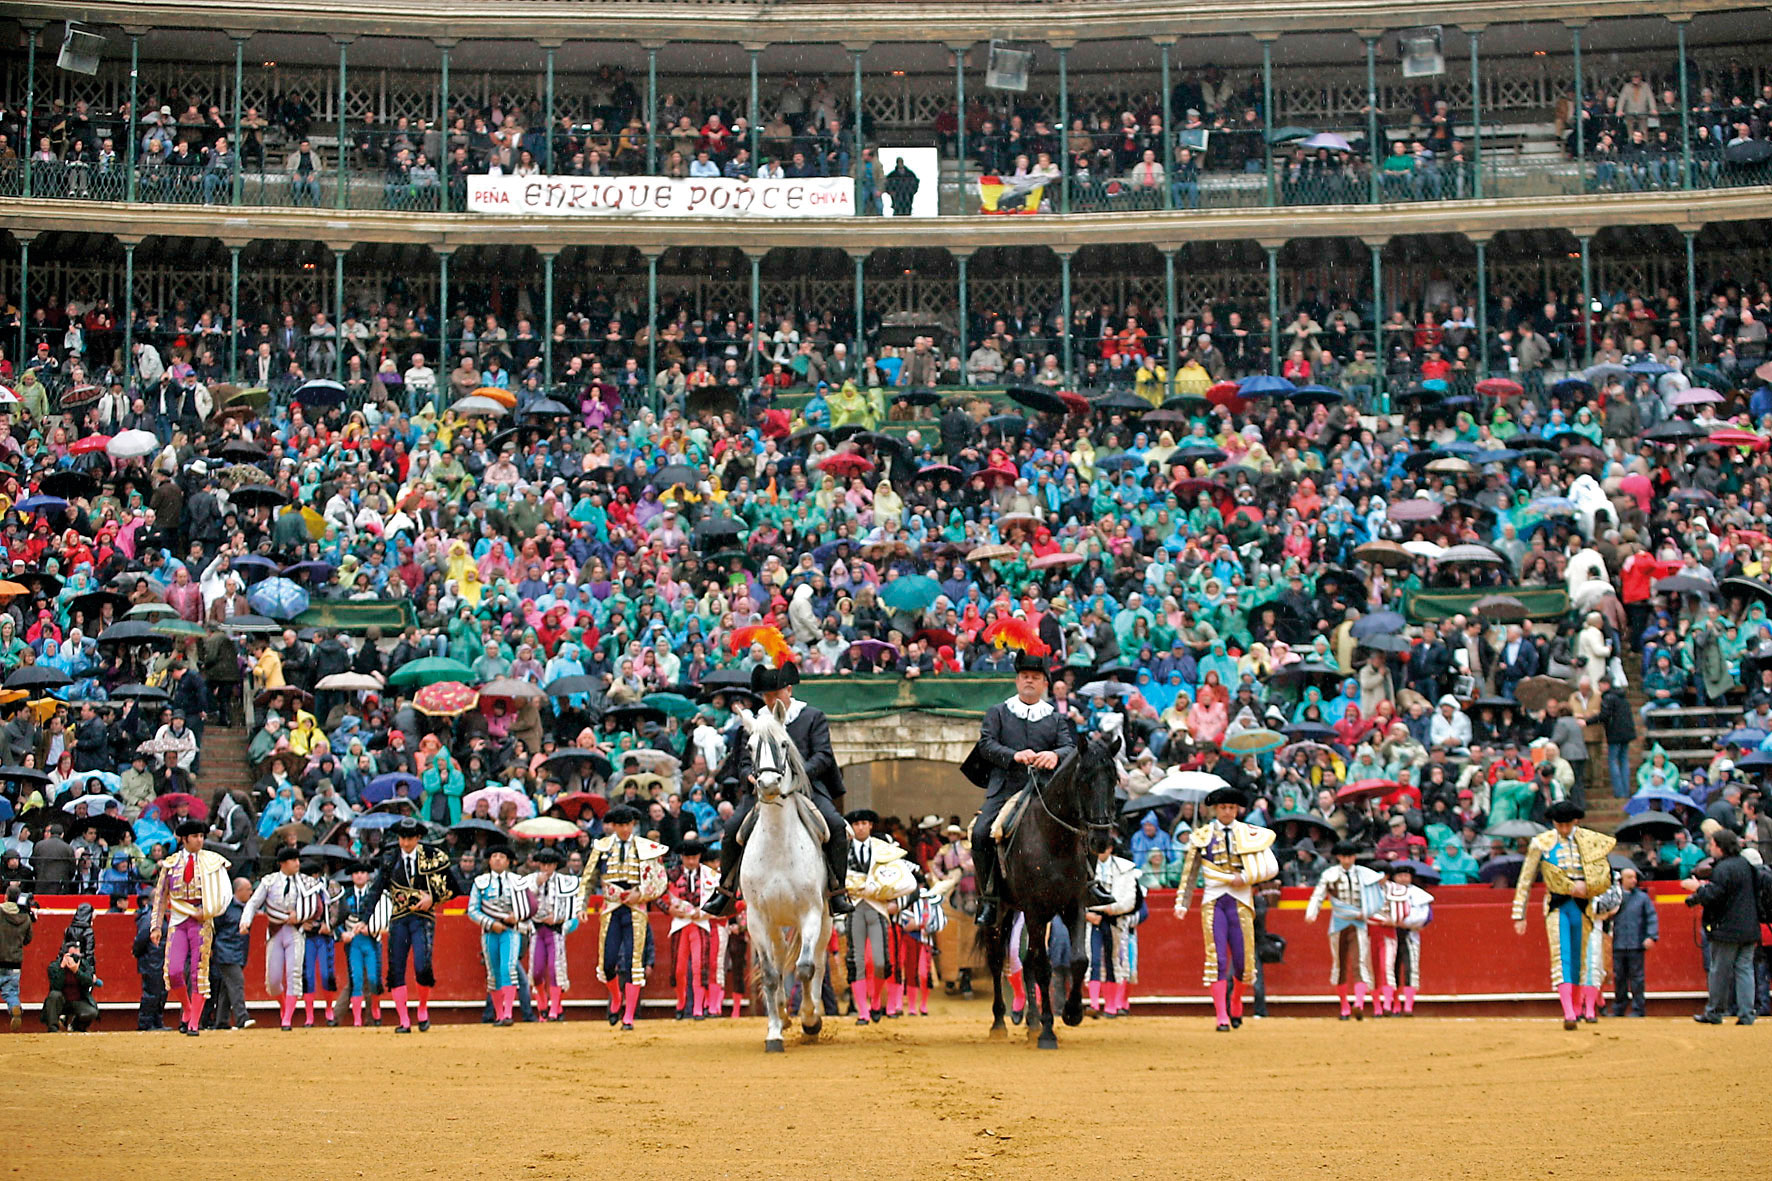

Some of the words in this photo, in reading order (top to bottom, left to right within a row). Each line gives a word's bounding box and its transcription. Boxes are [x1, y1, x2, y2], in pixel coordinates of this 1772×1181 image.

[475, 187, 510, 204] PEÑA
[525, 183, 672, 210] ENRIQUE
[687, 186, 804, 211] PONCE
[809, 192, 848, 205] CHIVA
